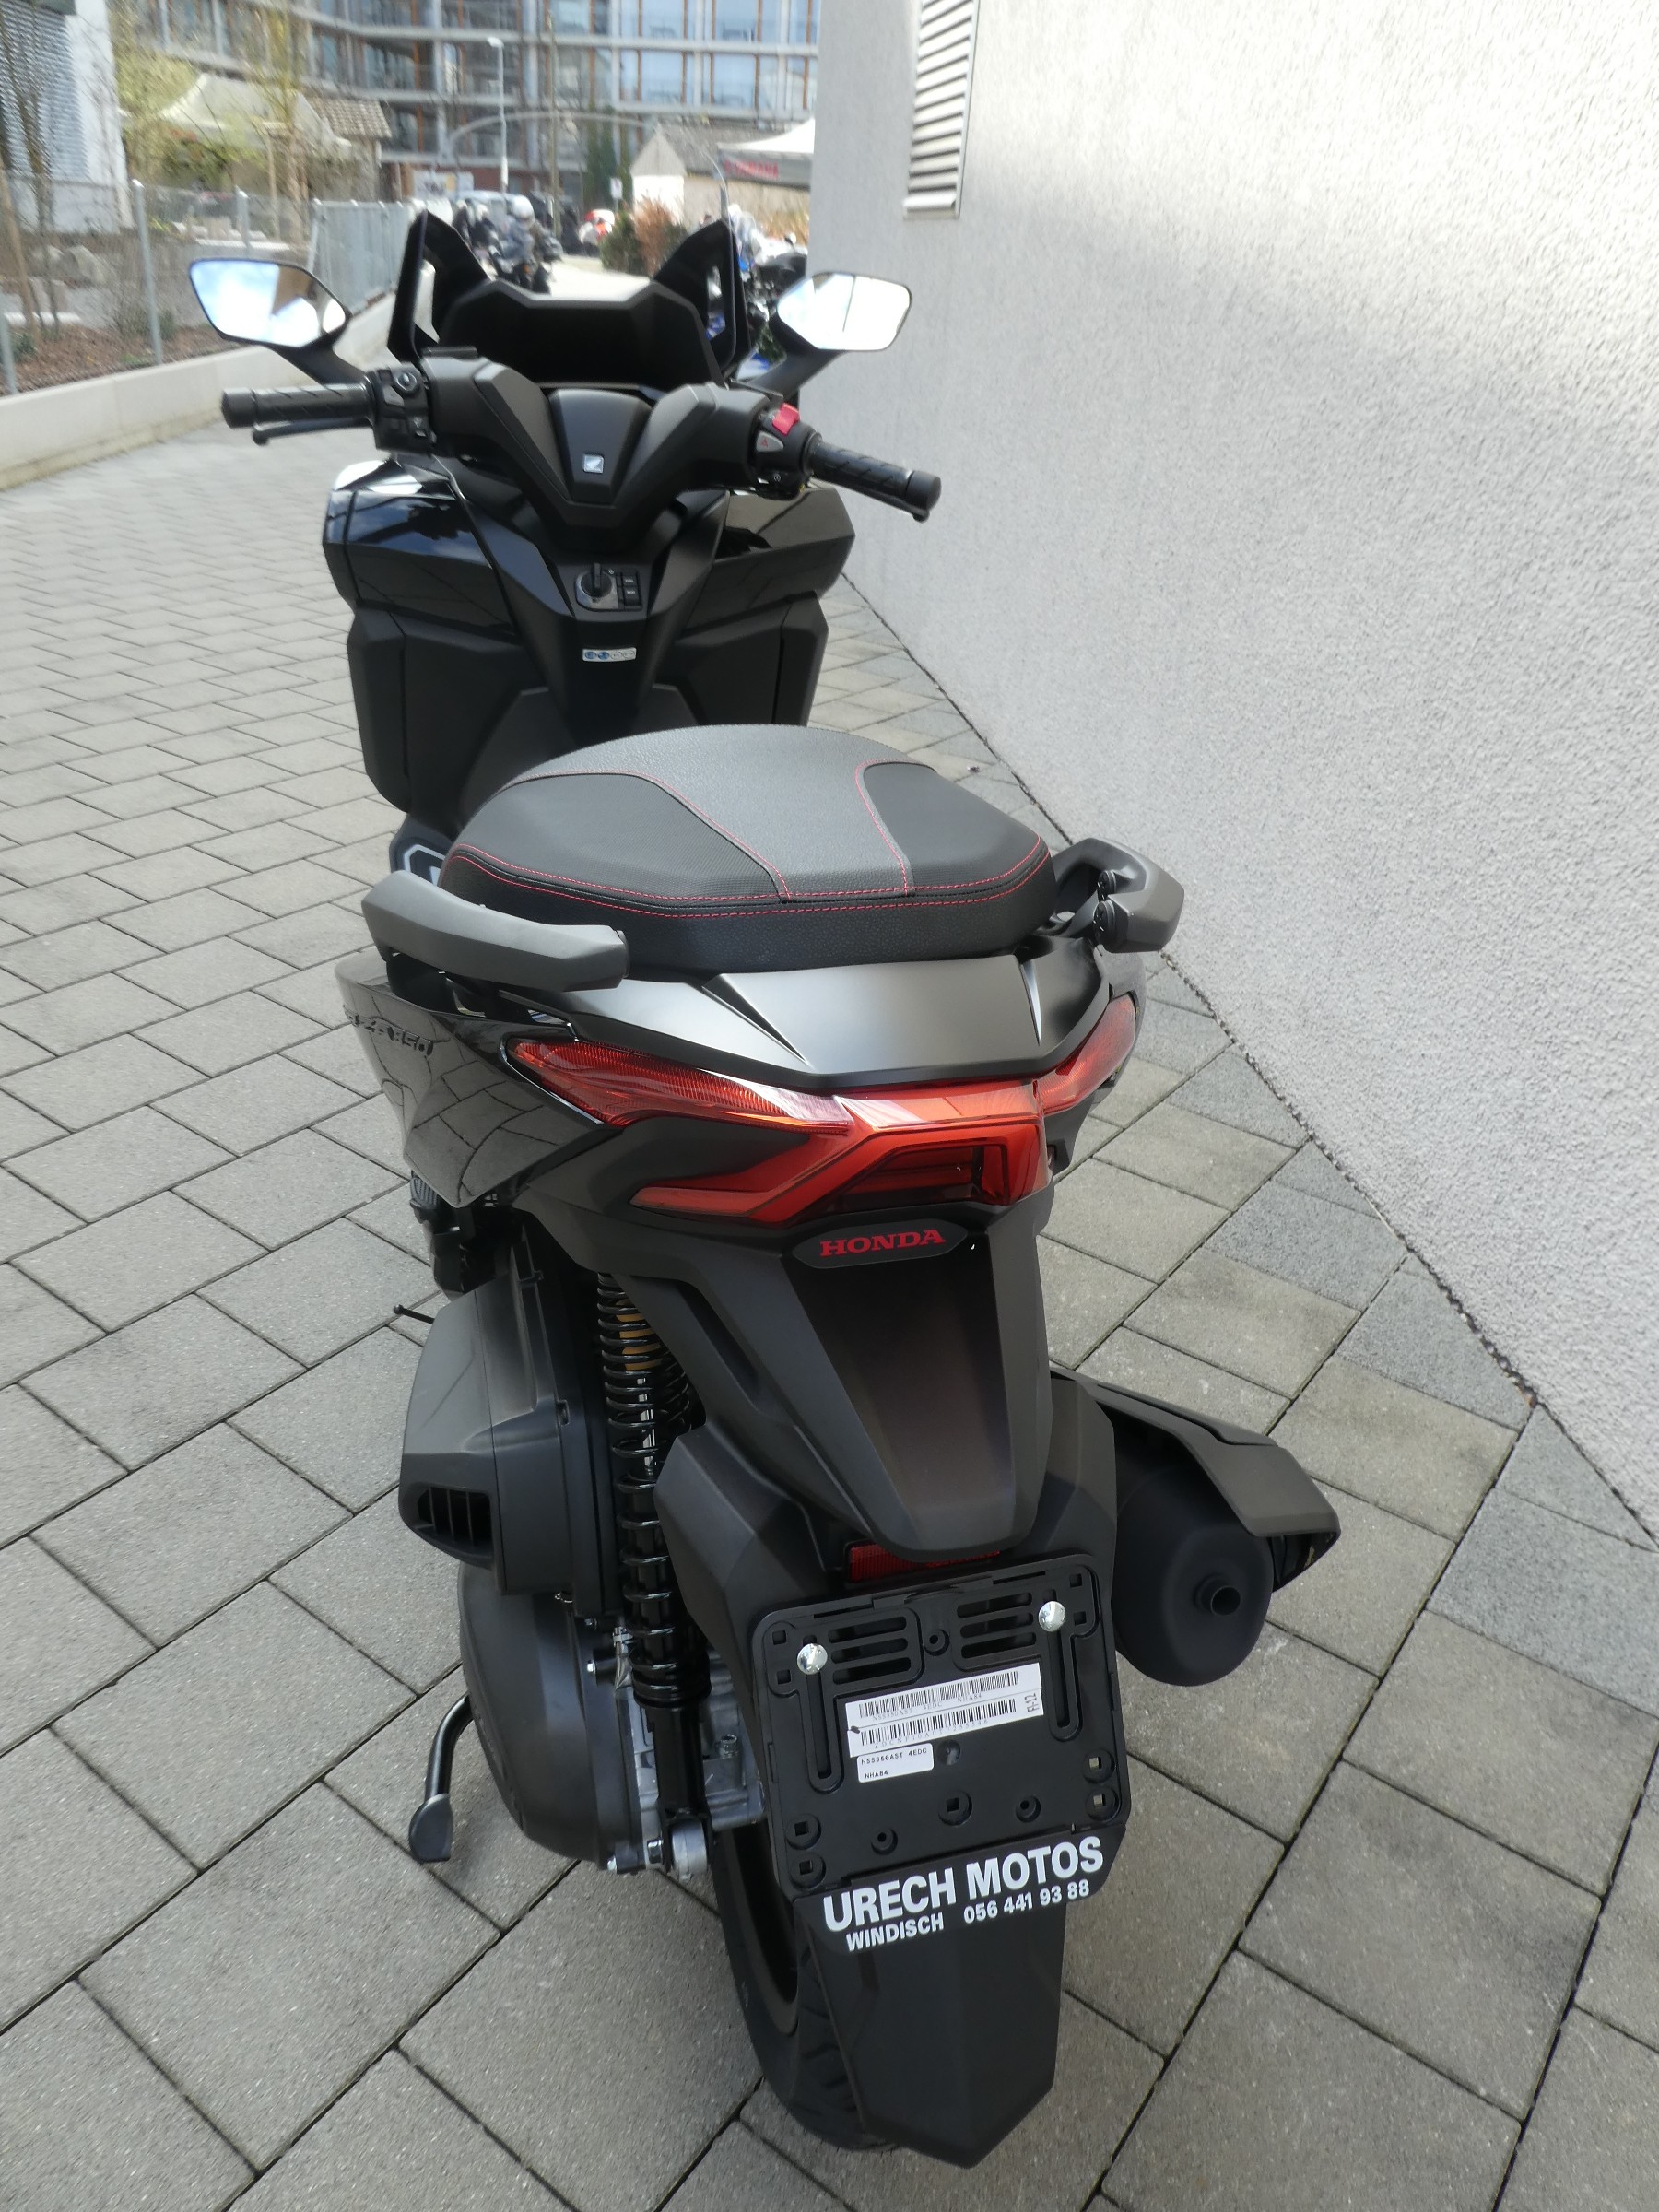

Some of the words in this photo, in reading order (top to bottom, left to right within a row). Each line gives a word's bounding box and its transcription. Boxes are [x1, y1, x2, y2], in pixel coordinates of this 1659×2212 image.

[819, 1229, 946, 1257] HONDA
[908, 1747, 927, 1757] 4EDC
[865, 1770, 888, 1779] NHA84
[823, 1867, 957, 1932] URECH
[966, 1836, 1104, 1900] MOTOS
[845, 1912, 944, 1952] WINDISCH
[963, 1899, 998, 1924] 056
[1003, 1891, 1033, 1914] 441
[1040, 1885, 1062, 1906] 93
[1067, 1878, 1089, 1900] 88
